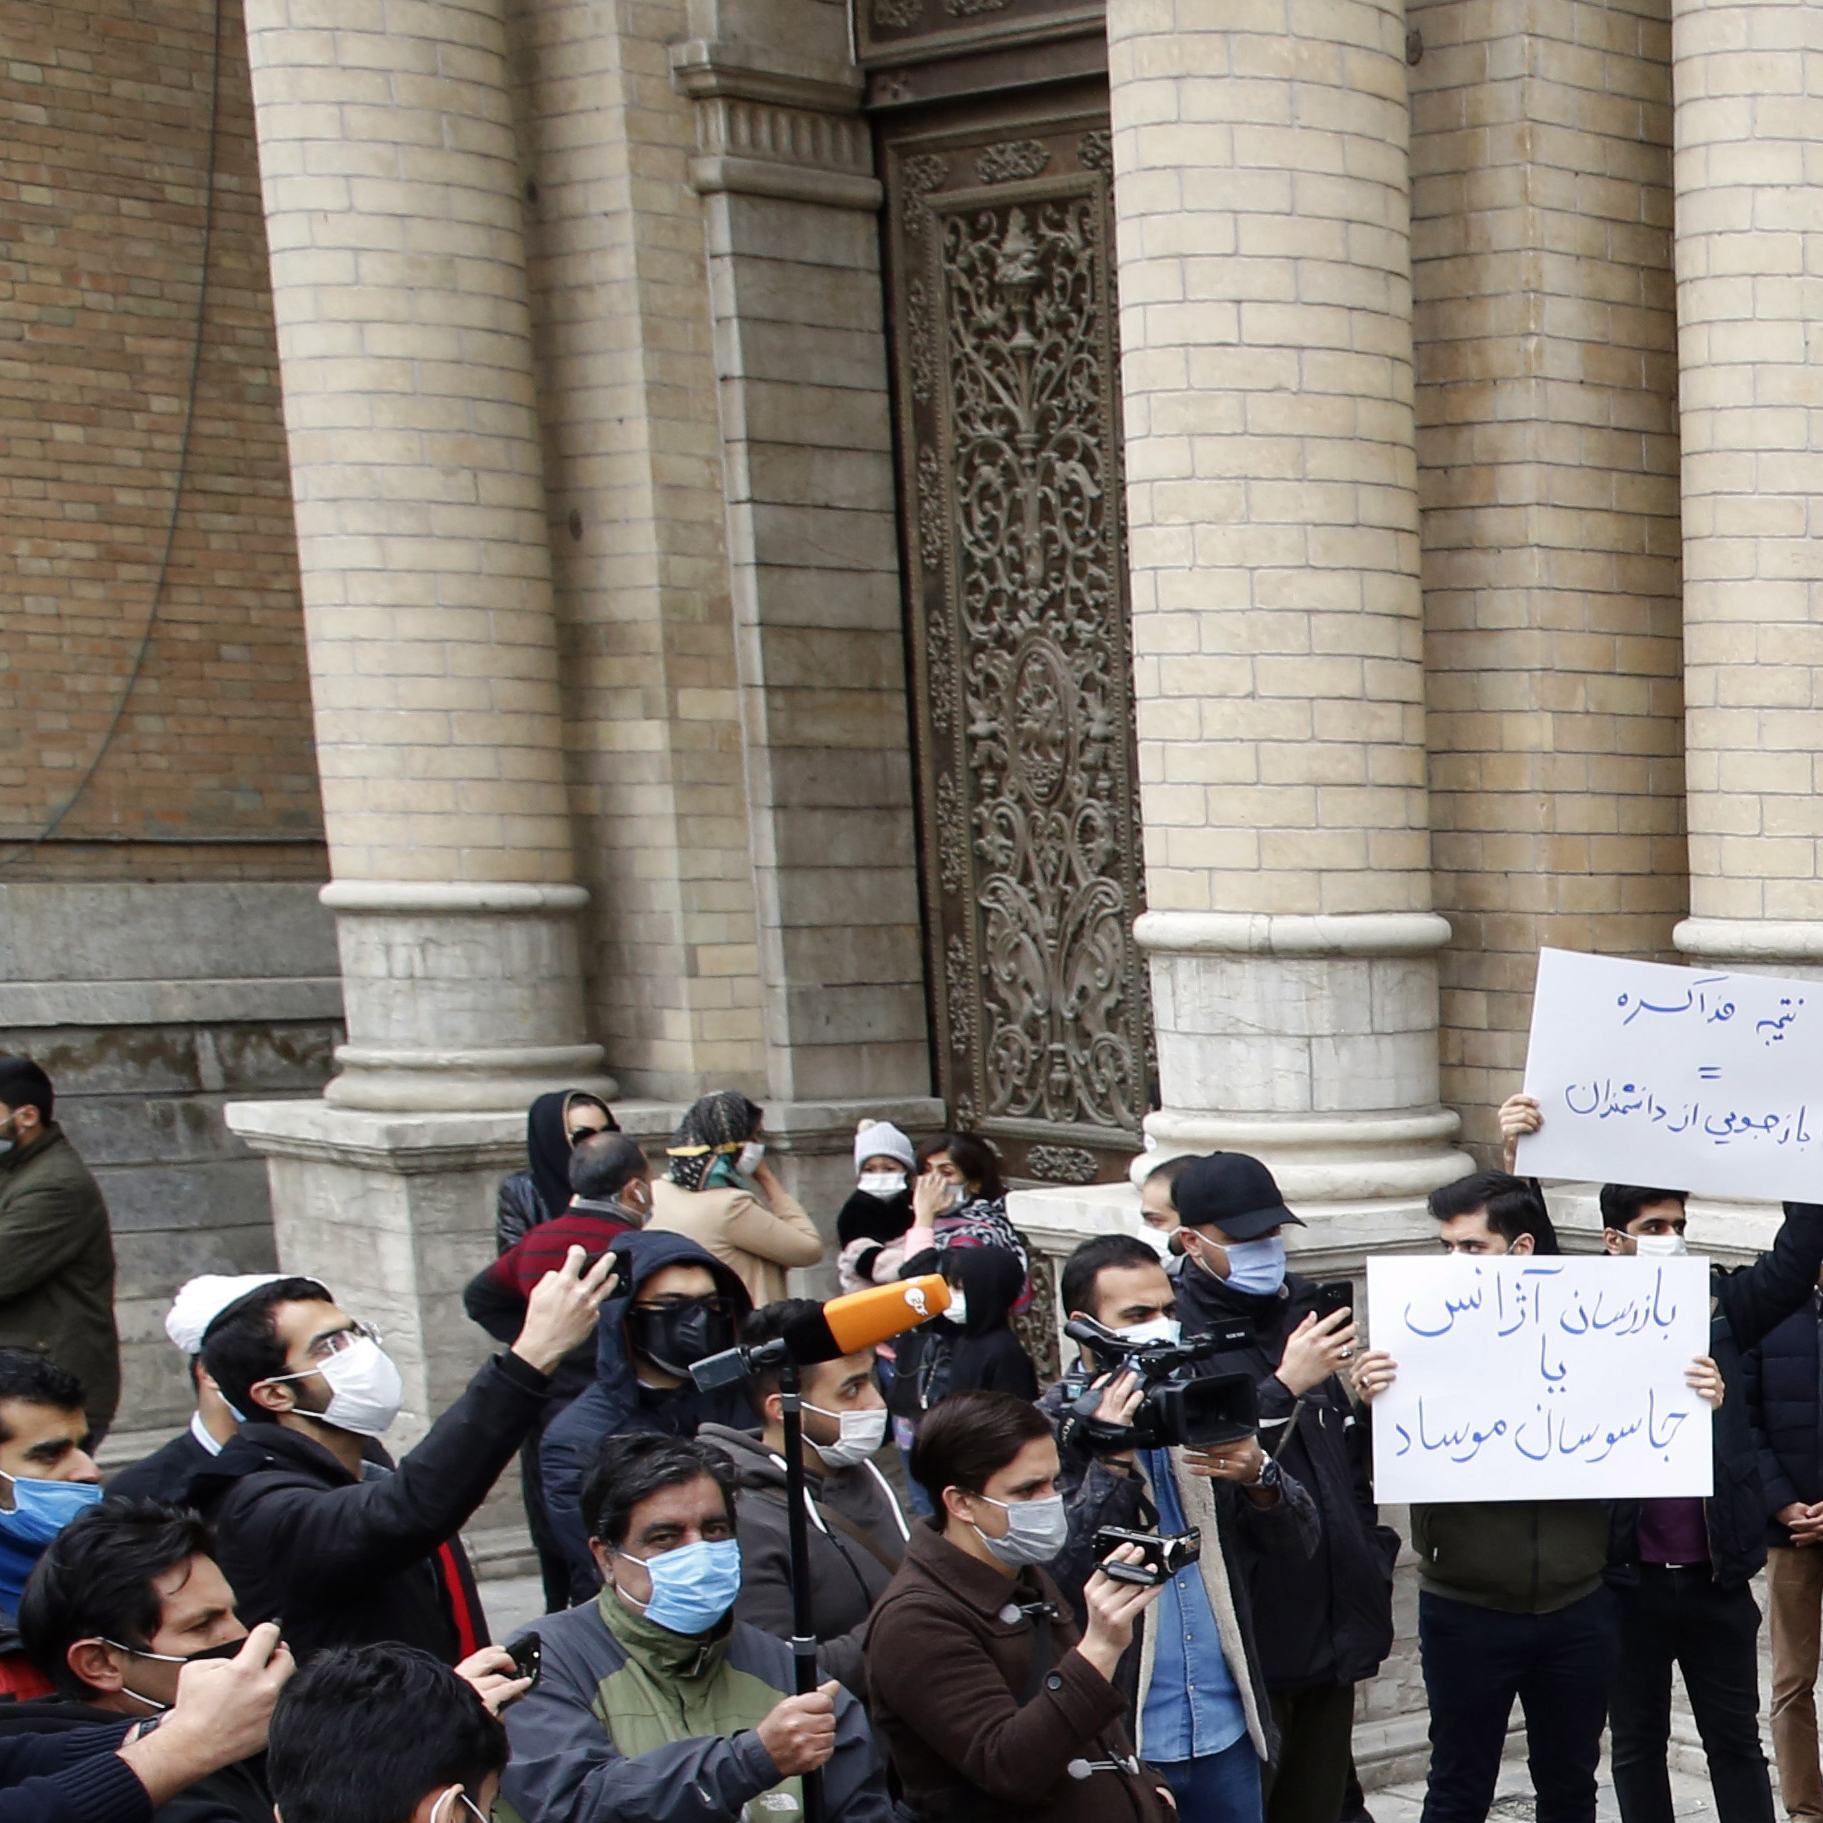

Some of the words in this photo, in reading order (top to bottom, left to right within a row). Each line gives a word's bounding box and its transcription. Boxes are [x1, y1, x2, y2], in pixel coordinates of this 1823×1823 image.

[1667, 1103, 1698, 1131] از
[1404, 1264, 1565, 1337] آژانس
[1559, 1266, 1677, 1340] بازرسان
[1540, 1333, 1566, 1393] یا
[1396, 1395, 1508, 1463] موساد
[1515, 1387, 1690, 1463] جاسوسان
